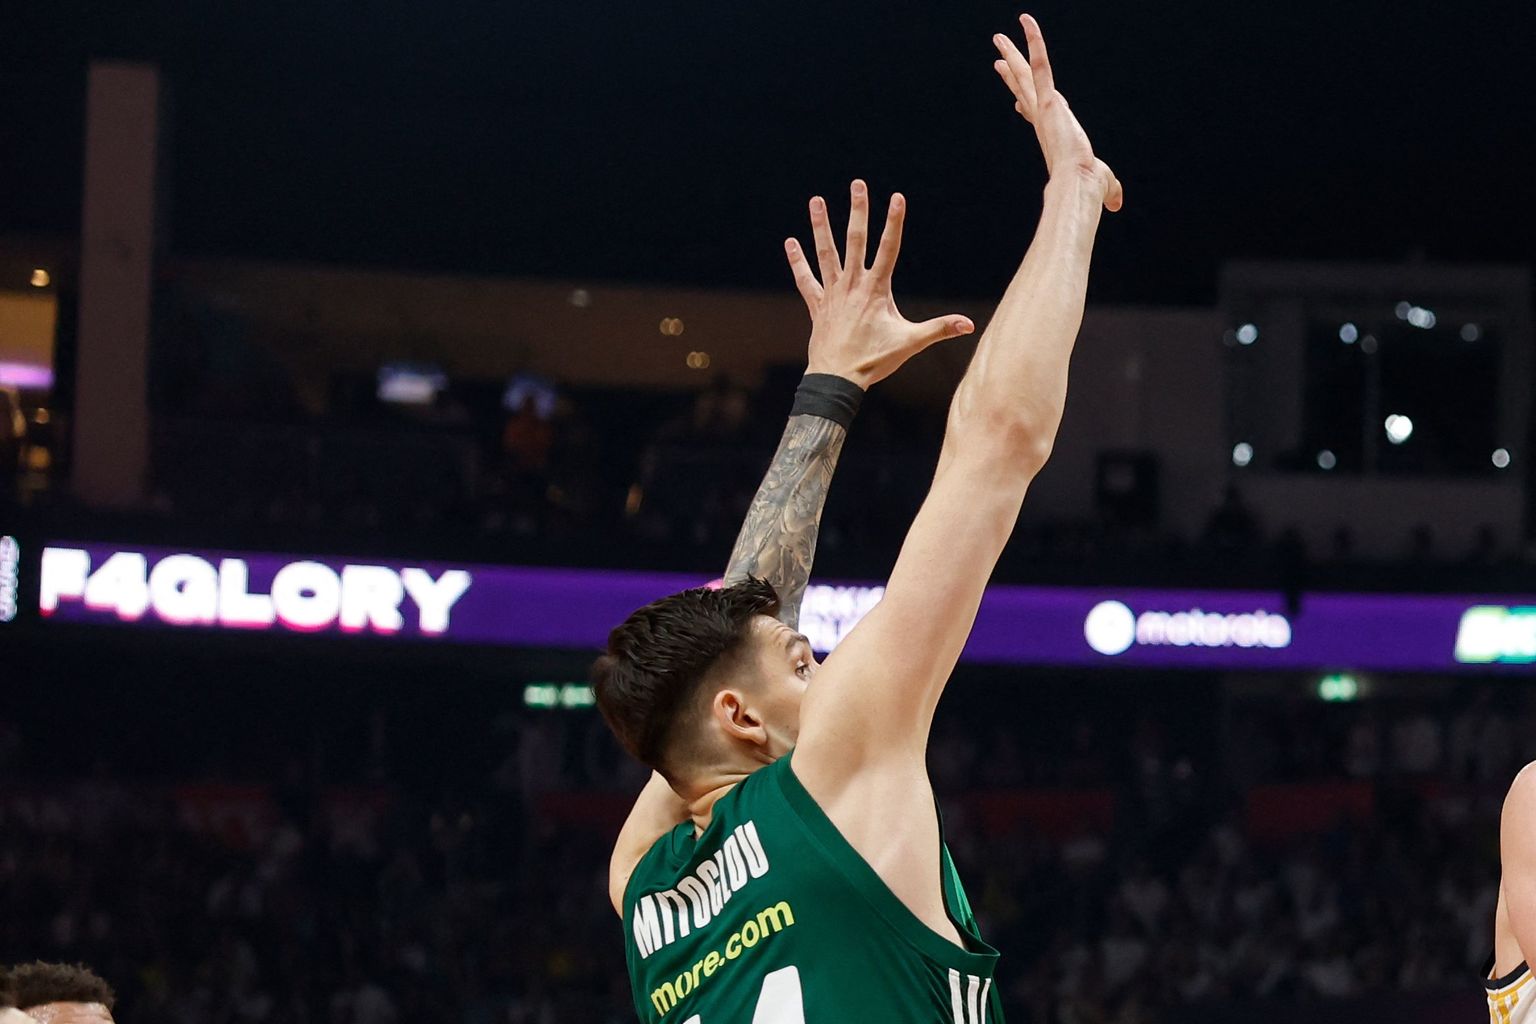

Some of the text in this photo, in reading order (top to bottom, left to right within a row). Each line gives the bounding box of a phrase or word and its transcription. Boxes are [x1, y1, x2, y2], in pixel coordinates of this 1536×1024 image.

[39, 545, 471, 634] F4GLORY
[633, 820, 770, 960] MITOGLOU
[650, 900, 795, 1017] more.com
